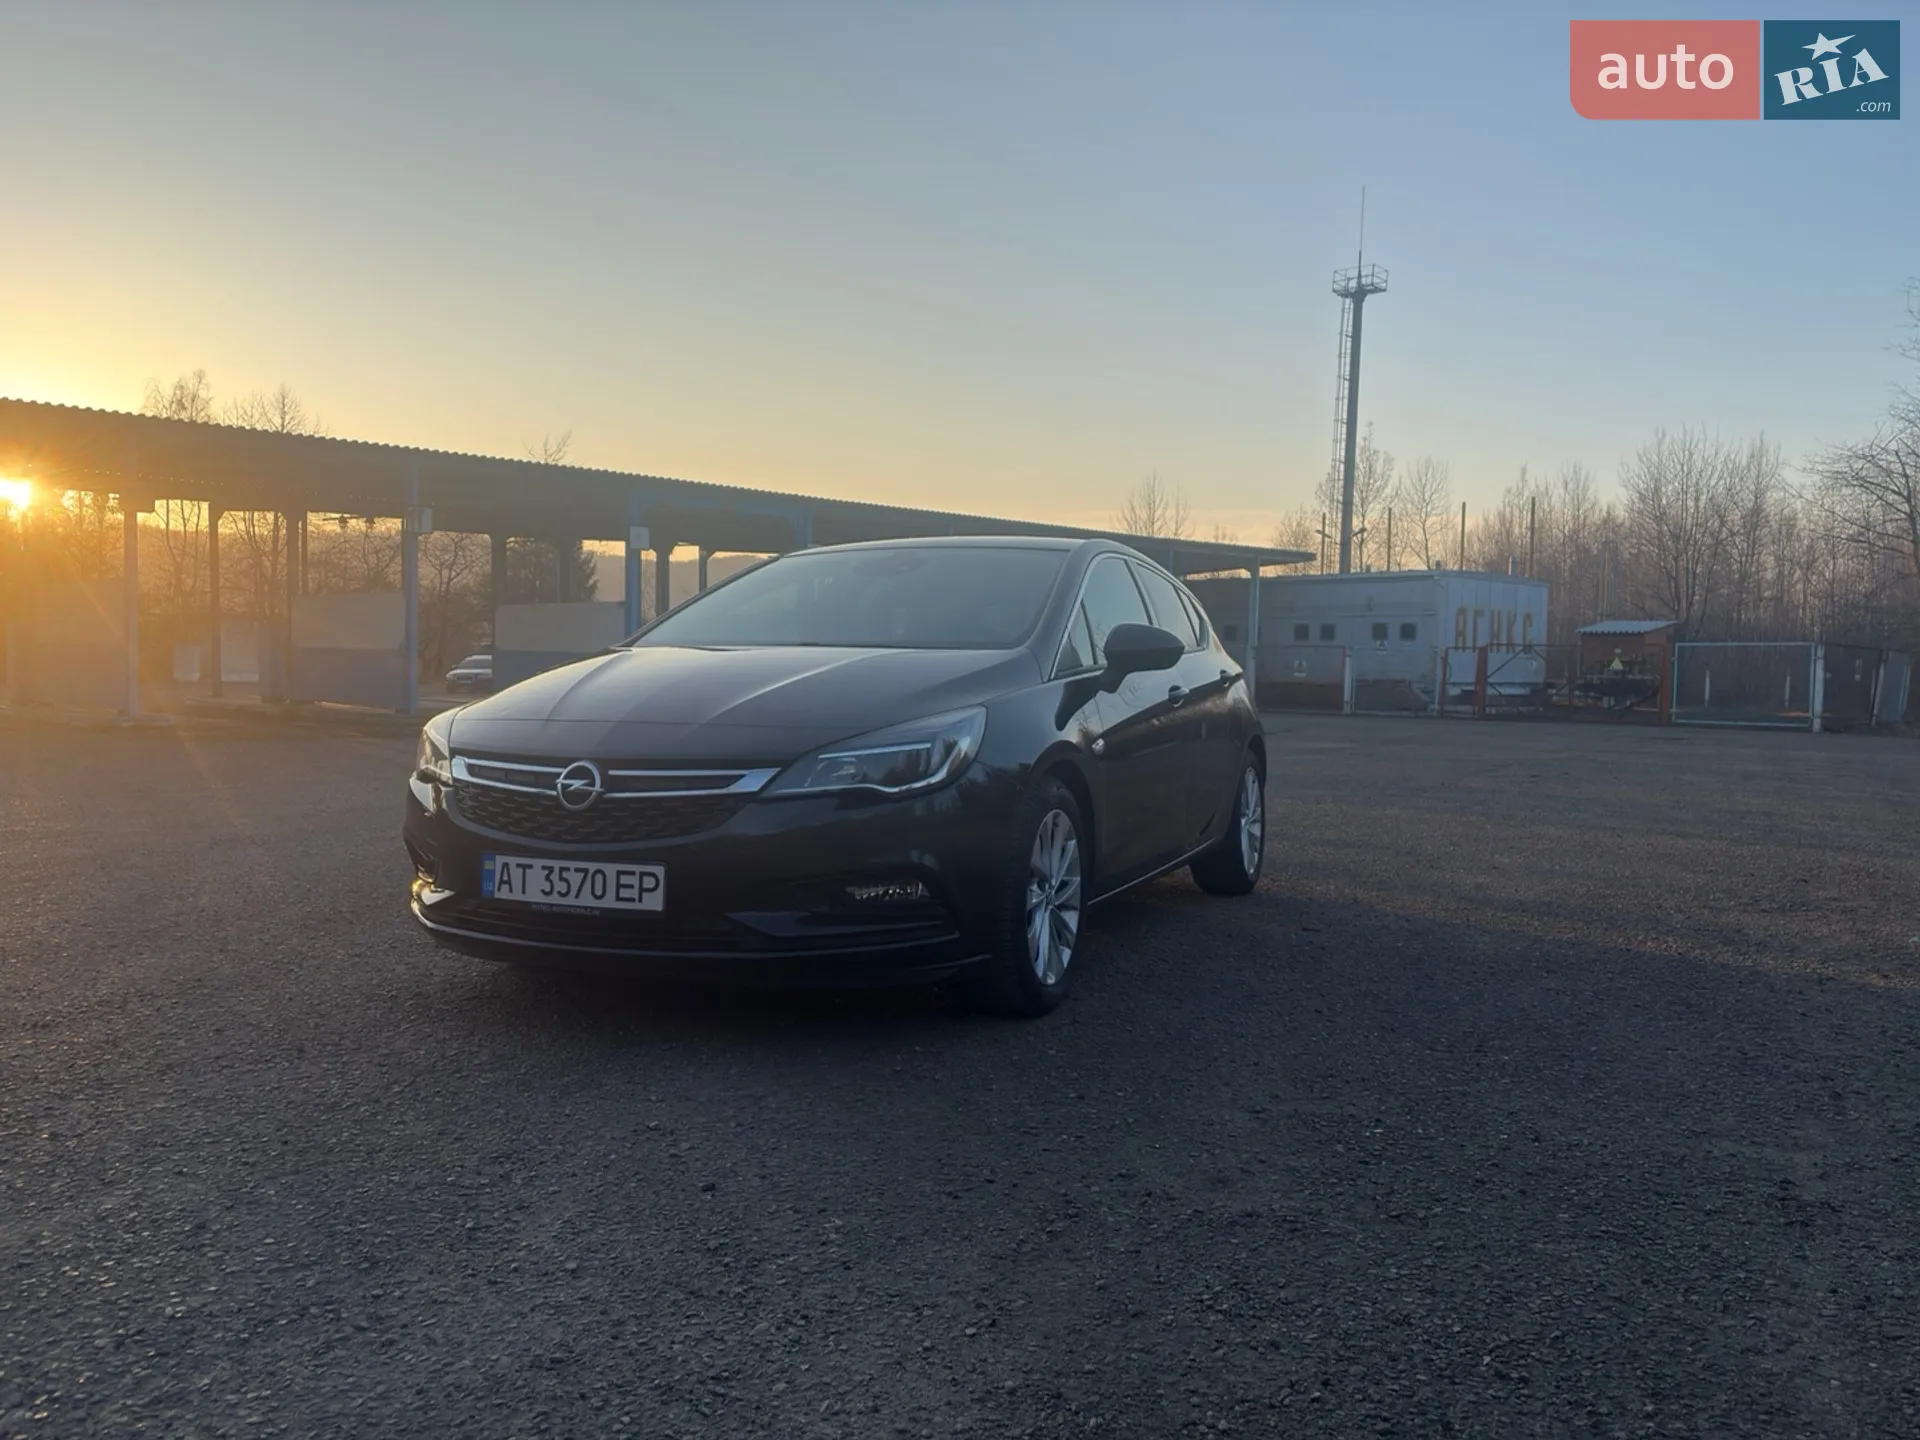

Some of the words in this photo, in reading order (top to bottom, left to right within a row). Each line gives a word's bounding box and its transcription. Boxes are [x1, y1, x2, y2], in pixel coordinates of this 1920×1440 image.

[497, 861, 534, 895] AT
[540, 864, 607, 901] 3570
[615, 869, 660, 903] EP
